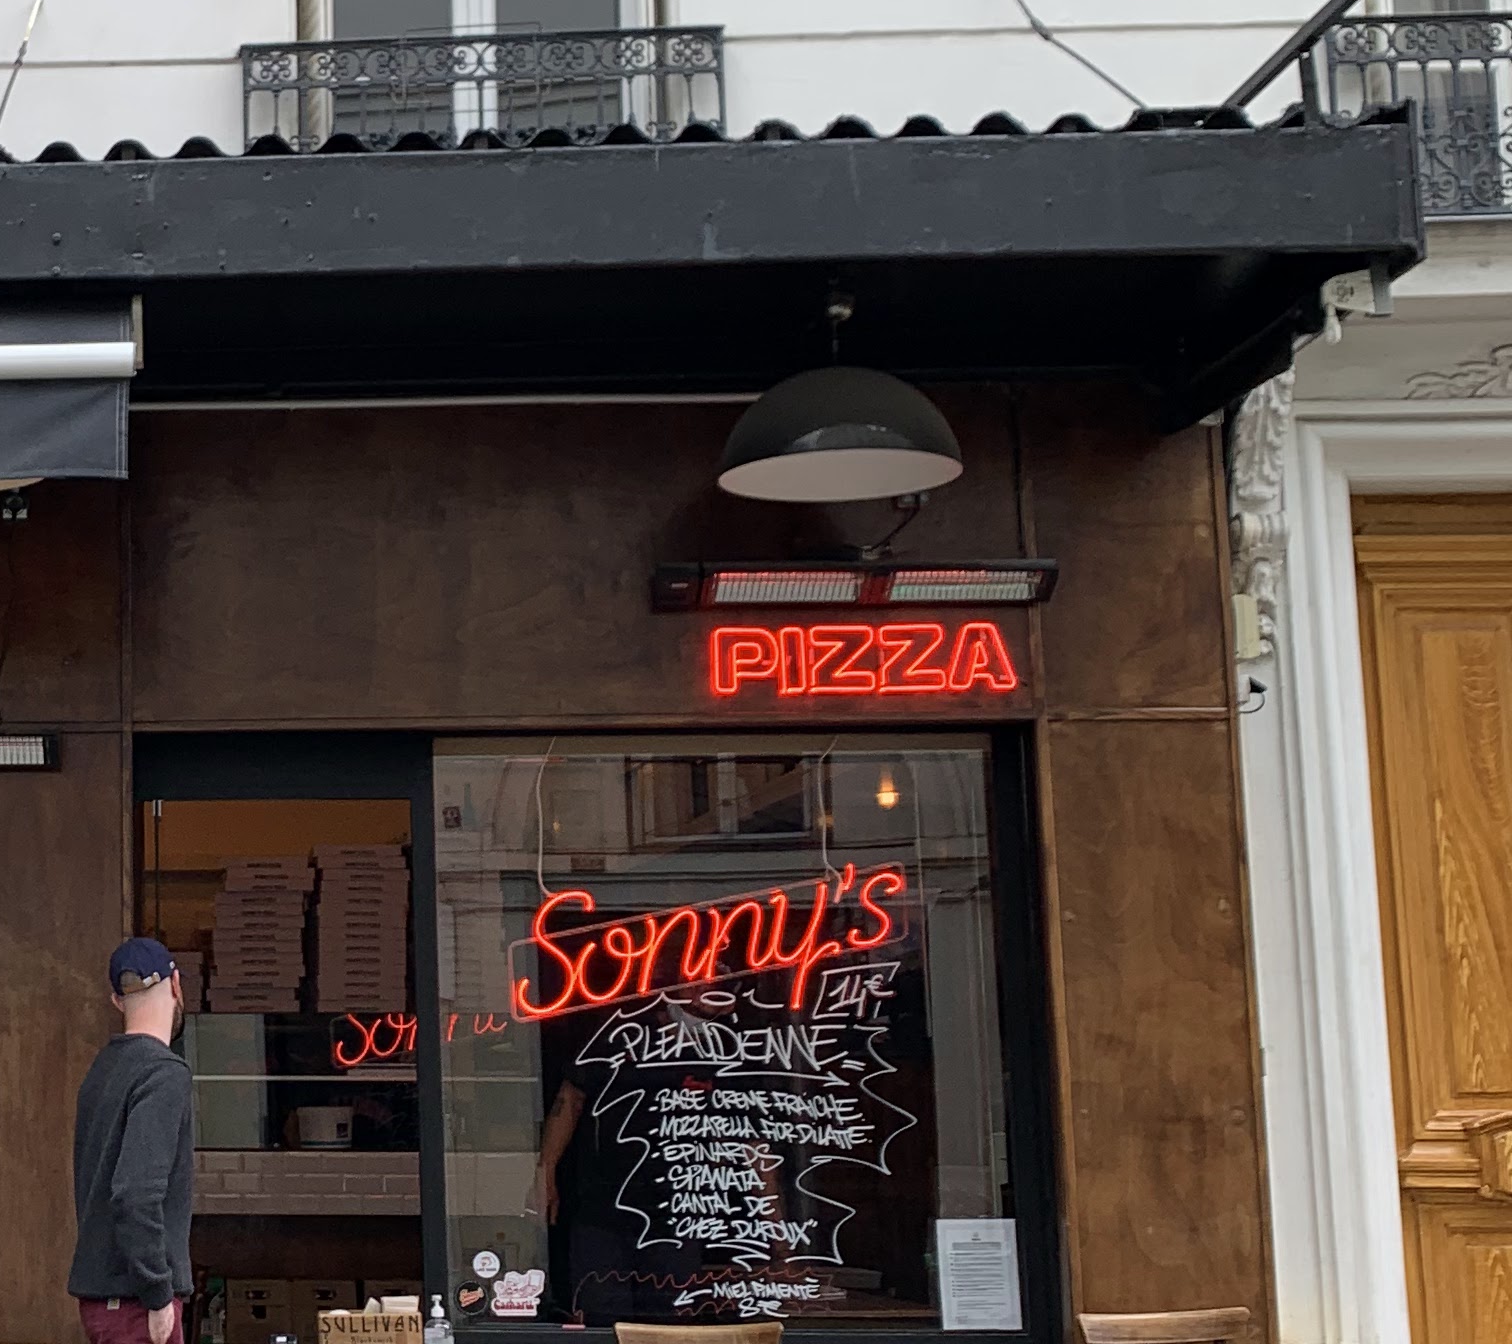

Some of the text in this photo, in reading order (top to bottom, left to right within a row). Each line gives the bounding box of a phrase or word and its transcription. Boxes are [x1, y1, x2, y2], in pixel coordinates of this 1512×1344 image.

[711, 622, 1019, 696] PIZZA
[513, 862, 907, 1020] Sonny's
[828, 973, 895, 1019] 14€
[744, 1195, 780, 1218] DE
[320, 1314, 420, 1334] SULLIVAN
